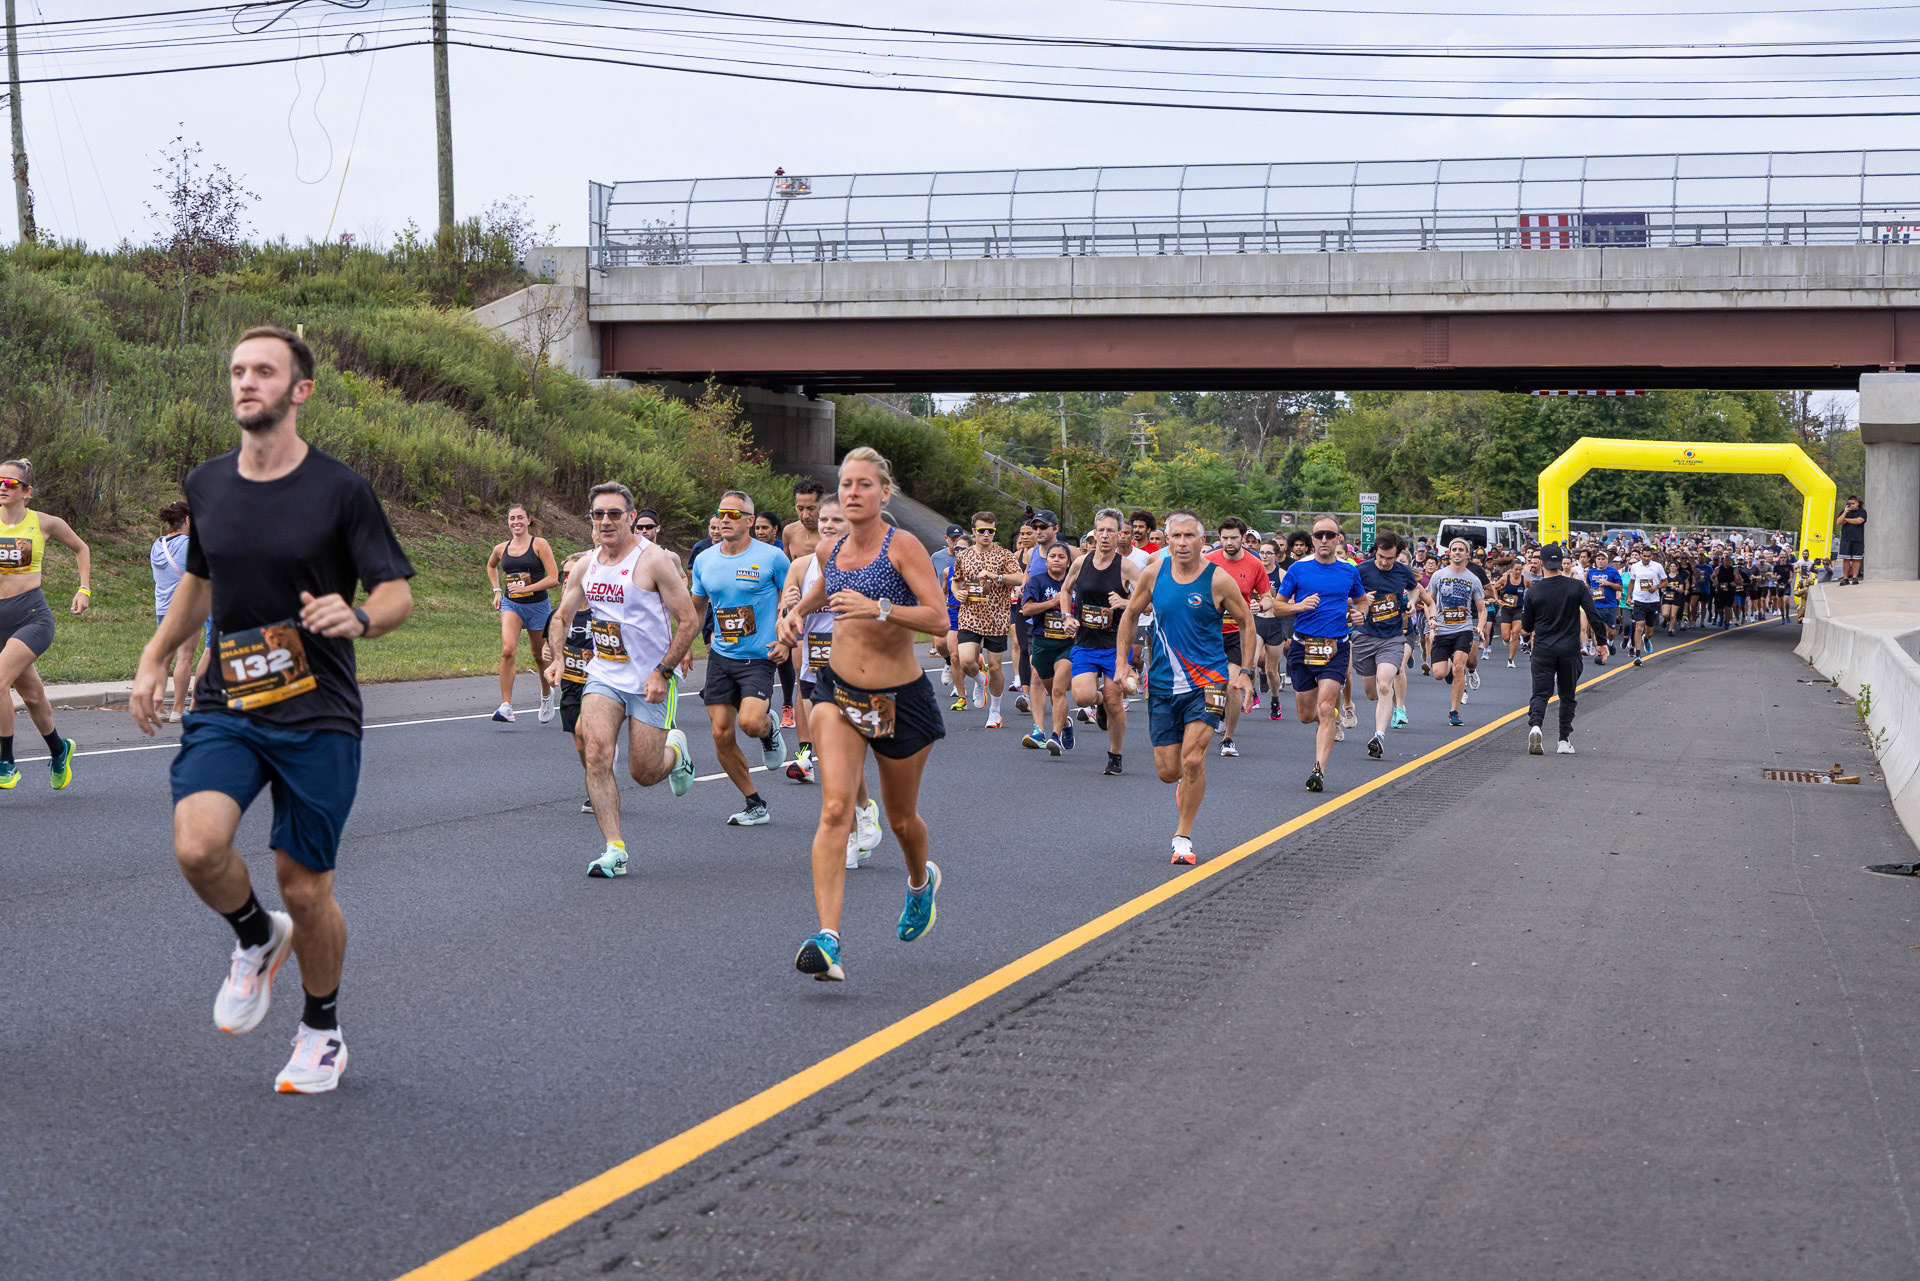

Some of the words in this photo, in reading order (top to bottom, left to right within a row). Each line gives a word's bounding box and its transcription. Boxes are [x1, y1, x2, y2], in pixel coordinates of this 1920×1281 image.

[737, 570, 759, 578] MALIBU
[586, 582, 625, 597] LEONIA
[606, 595, 625, 604] CLUB
[1373, 602, 1395, 612] 143
[724, 618, 745, 631] 67
[1084, 613, 1108, 624] 241
[594, 632, 620, 648] 699
[1309, 646, 1333, 654] 219
[230, 648, 294, 681] 132
[840, 706, 882, 726] 24
